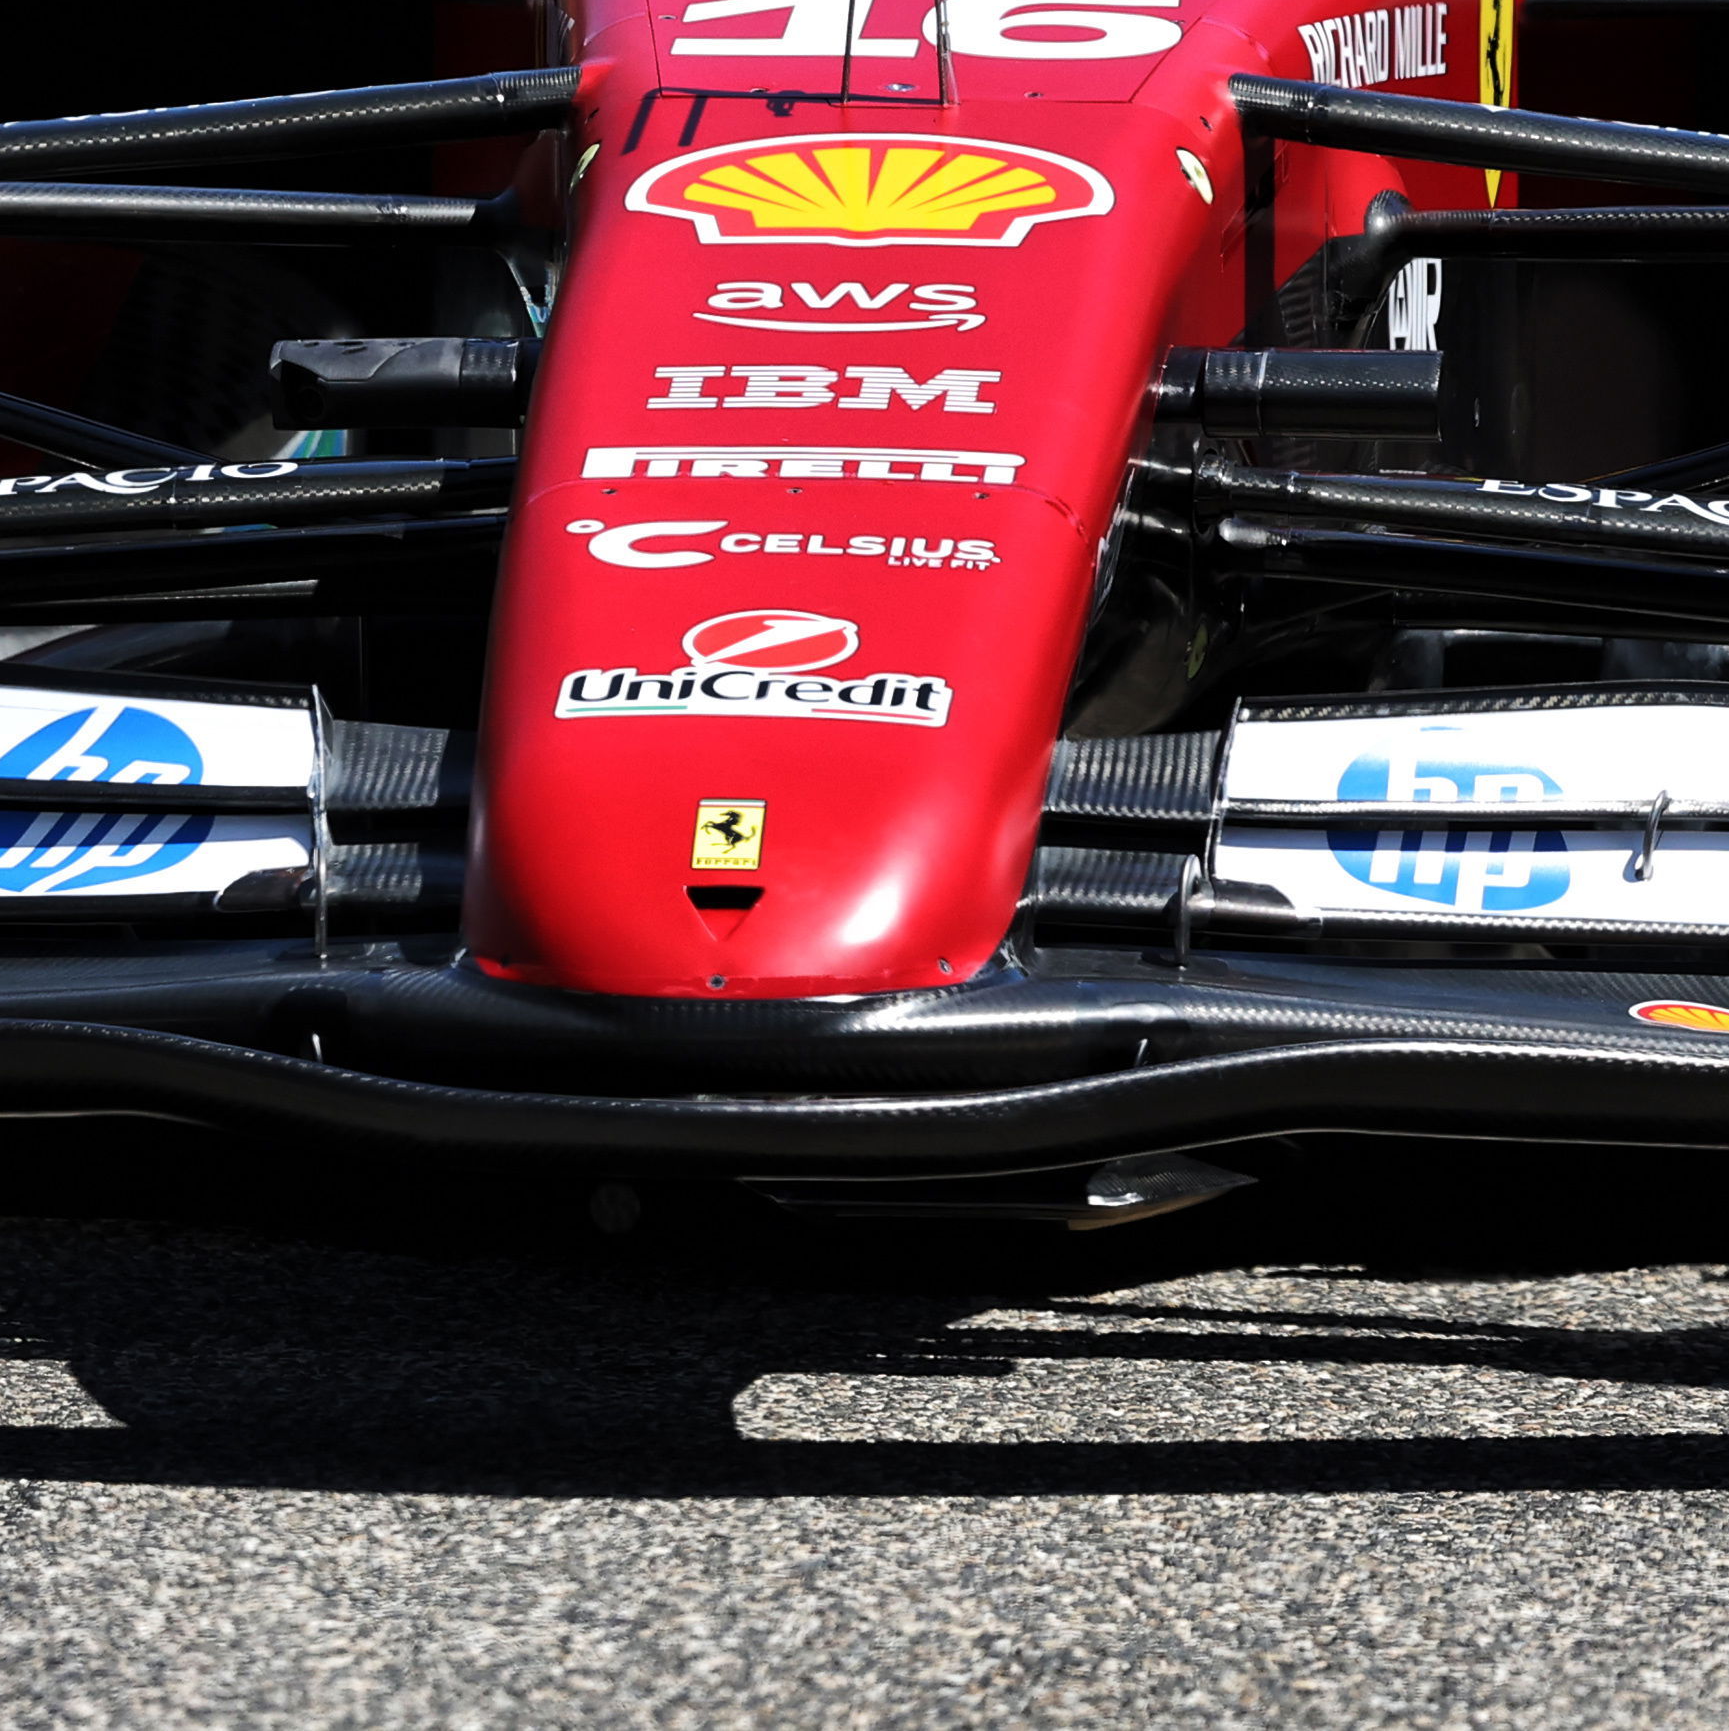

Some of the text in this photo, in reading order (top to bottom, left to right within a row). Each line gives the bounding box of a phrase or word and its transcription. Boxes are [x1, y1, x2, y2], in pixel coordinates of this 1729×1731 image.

[1297, 2, 1448, 89] RICHARD MILLE
[706, 281, 978, 312] aws
[646, 365, 1002, 414] IBM
[579, 447, 1027, 484] PIRELLI
[720, 532, 996, 561] CELSIUS
[887, 556, 991, 571] LIVE FIT
[568, 670, 943, 711] UniCredit
[1344, 726, 1562, 910] hp
